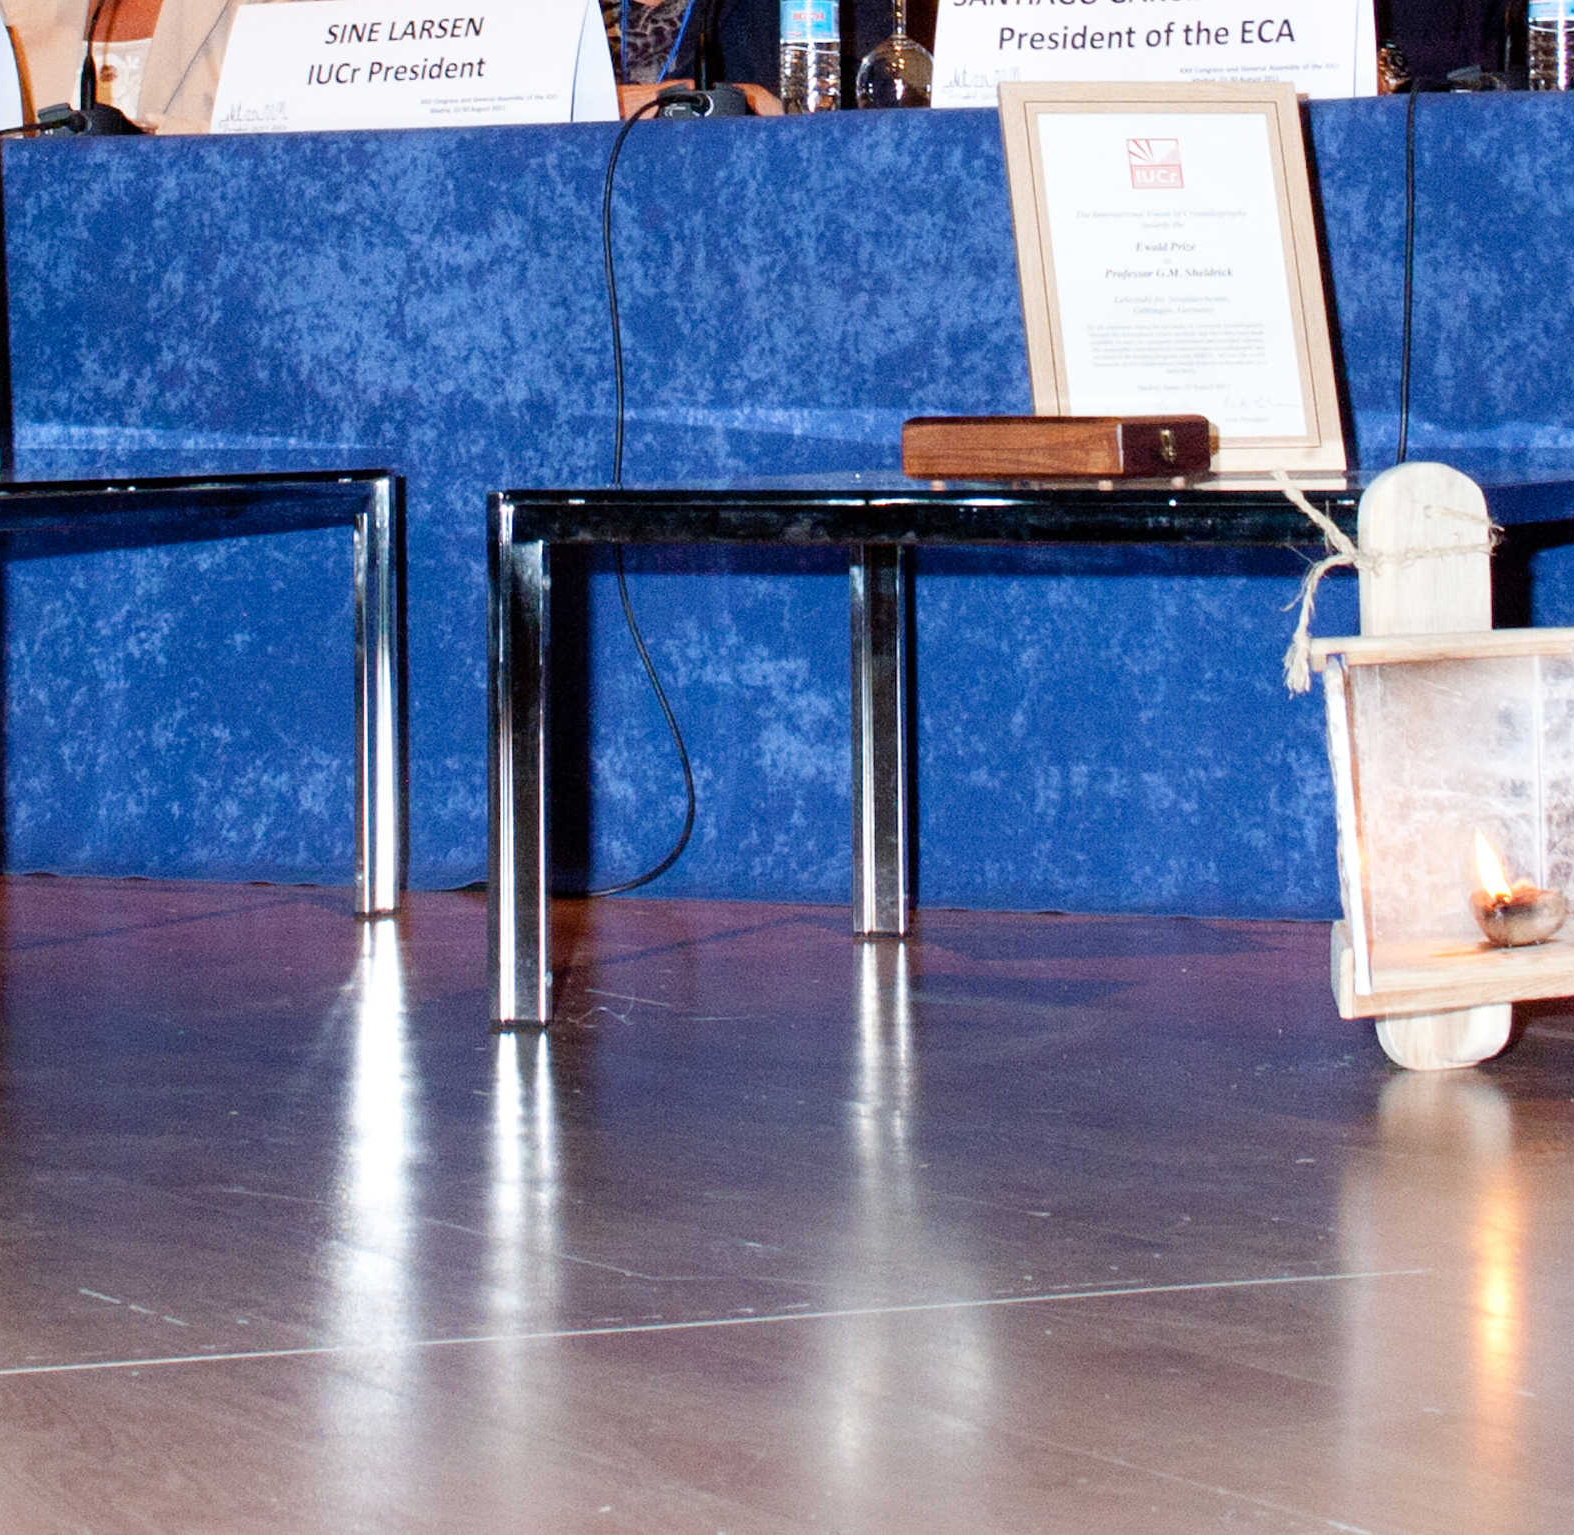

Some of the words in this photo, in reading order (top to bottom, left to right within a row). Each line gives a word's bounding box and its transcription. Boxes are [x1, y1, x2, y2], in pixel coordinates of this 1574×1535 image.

[325, 22, 382, 44] SINE
[389, 17, 484, 41] LARSEN
[999, 25, 1136, 50] President
[1146, 22, 1175, 47] of
[1183, 21, 1229, 46] the
[1241, 19, 1295, 44] ECA
[308, 63, 360, 85] IUCr
[369, 57, 485, 82] President
[1136, 168, 1178, 185] IUCr
